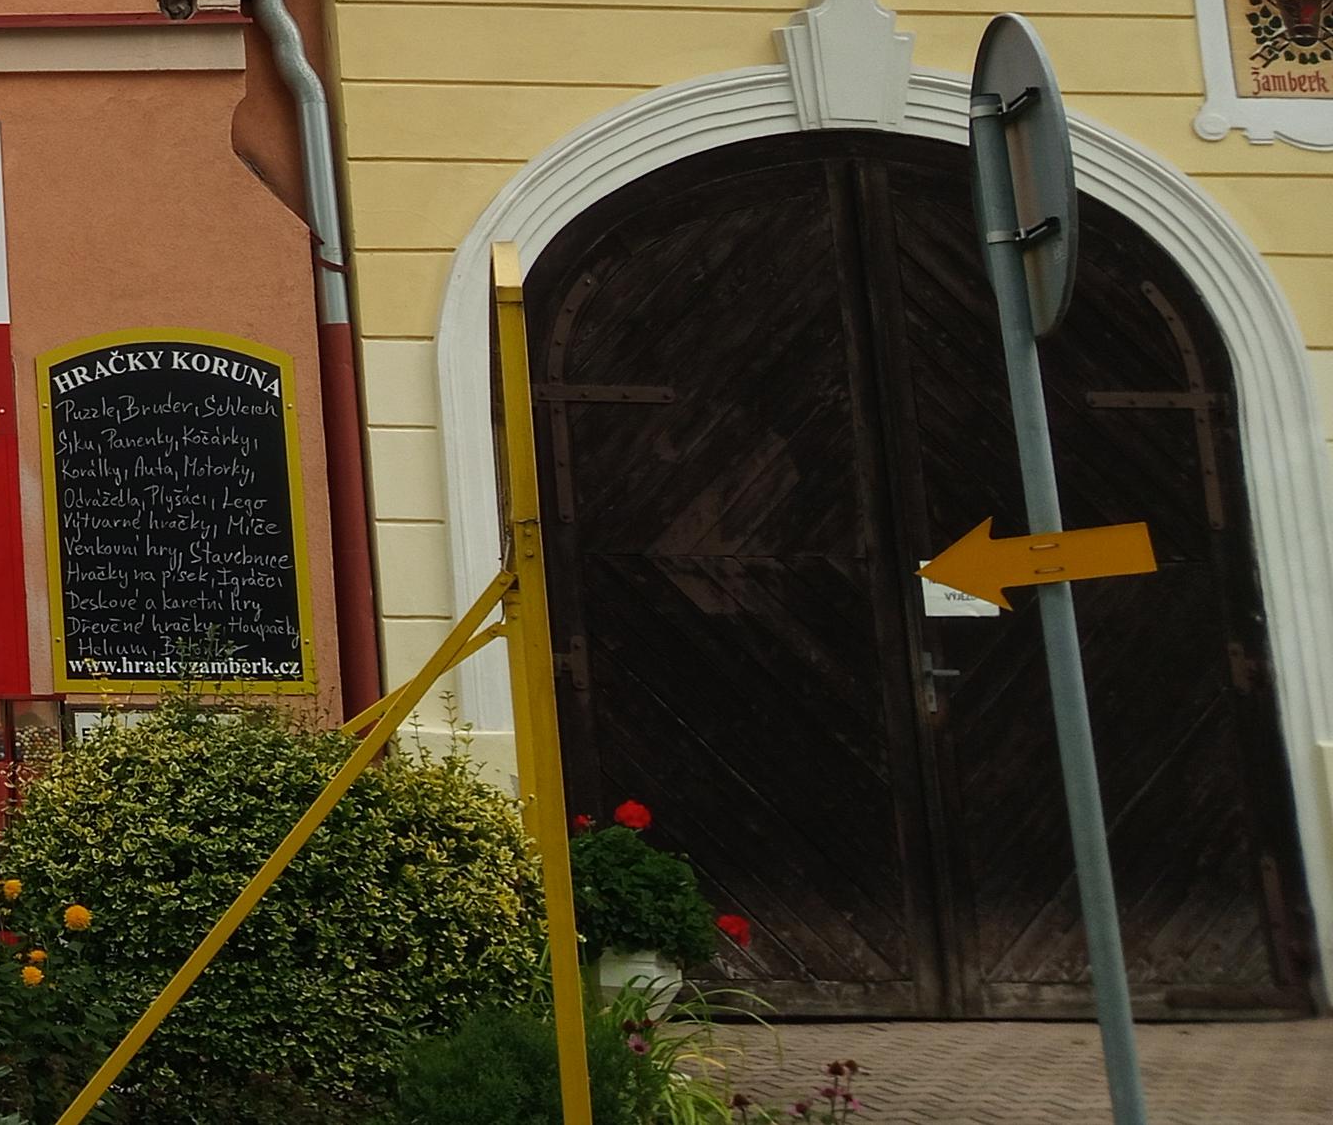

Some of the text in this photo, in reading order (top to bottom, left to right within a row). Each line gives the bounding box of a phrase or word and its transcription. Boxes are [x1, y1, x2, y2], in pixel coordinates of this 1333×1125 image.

[1251, 67, 1330, 95] Žamberk
[52, 350, 281, 398] HRAČKY KORUNA
[202, 394, 279, 419] Schleich
[134, 455, 179, 482] Auta,
[222, 486, 269, 516] Lego
[190, 540, 293, 570] Stavebnice
[133, 568, 156, 583] na
[65, 588, 264, 622] Deskové a karetní hry
[68, 656, 301, 675] www.hrackyzamberk.cz
